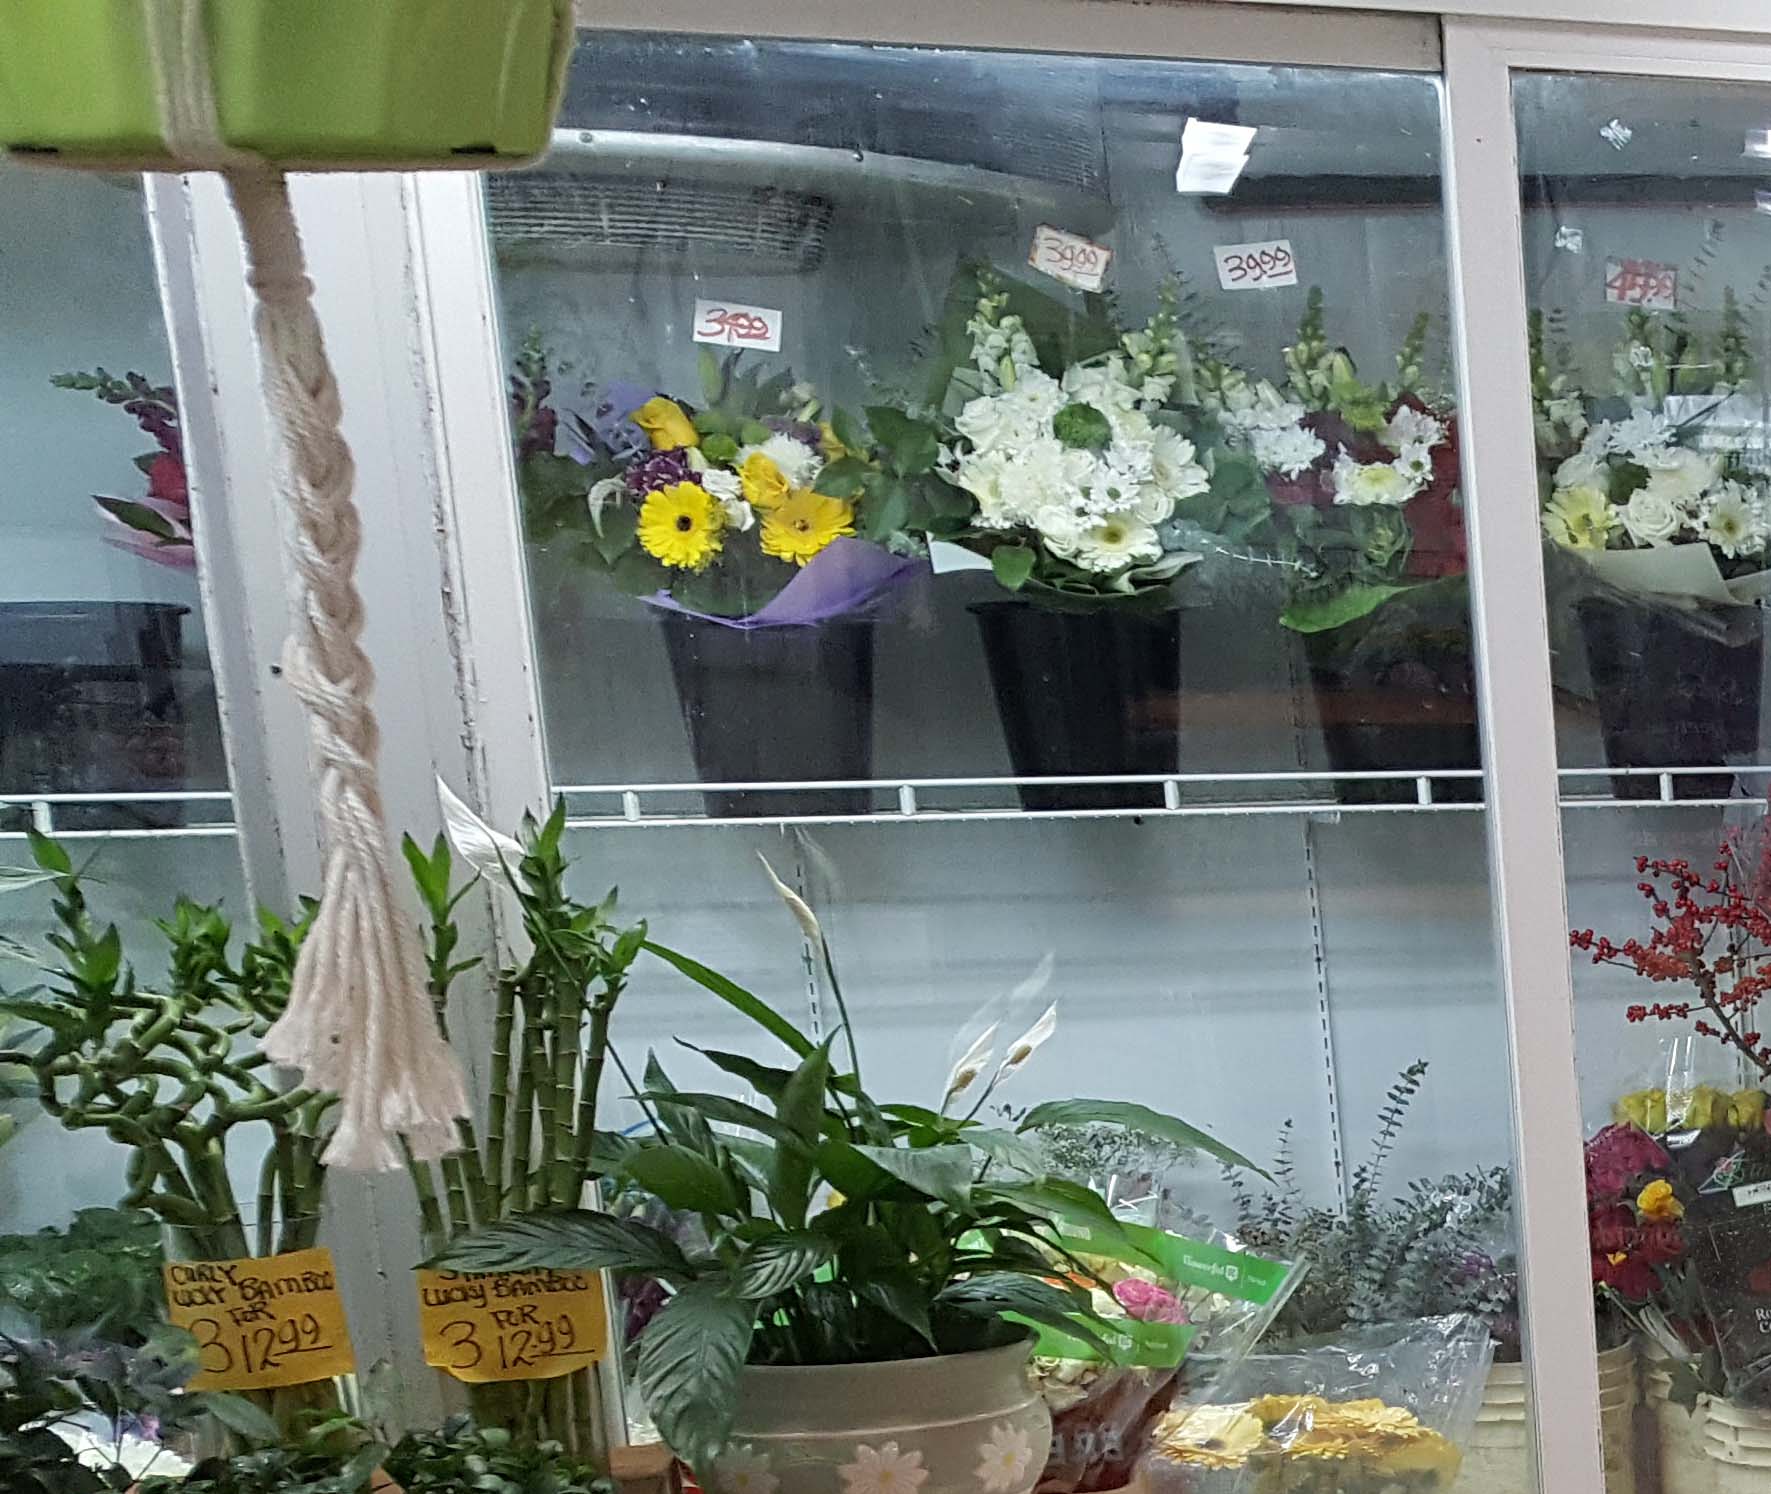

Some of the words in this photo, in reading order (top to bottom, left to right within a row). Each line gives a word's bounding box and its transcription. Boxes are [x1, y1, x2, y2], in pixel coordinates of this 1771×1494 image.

[1224, 245, 1291, 282] 3999
[189, 1318, 234, 1374] 3
[439, 1320, 483, 1369] 3
